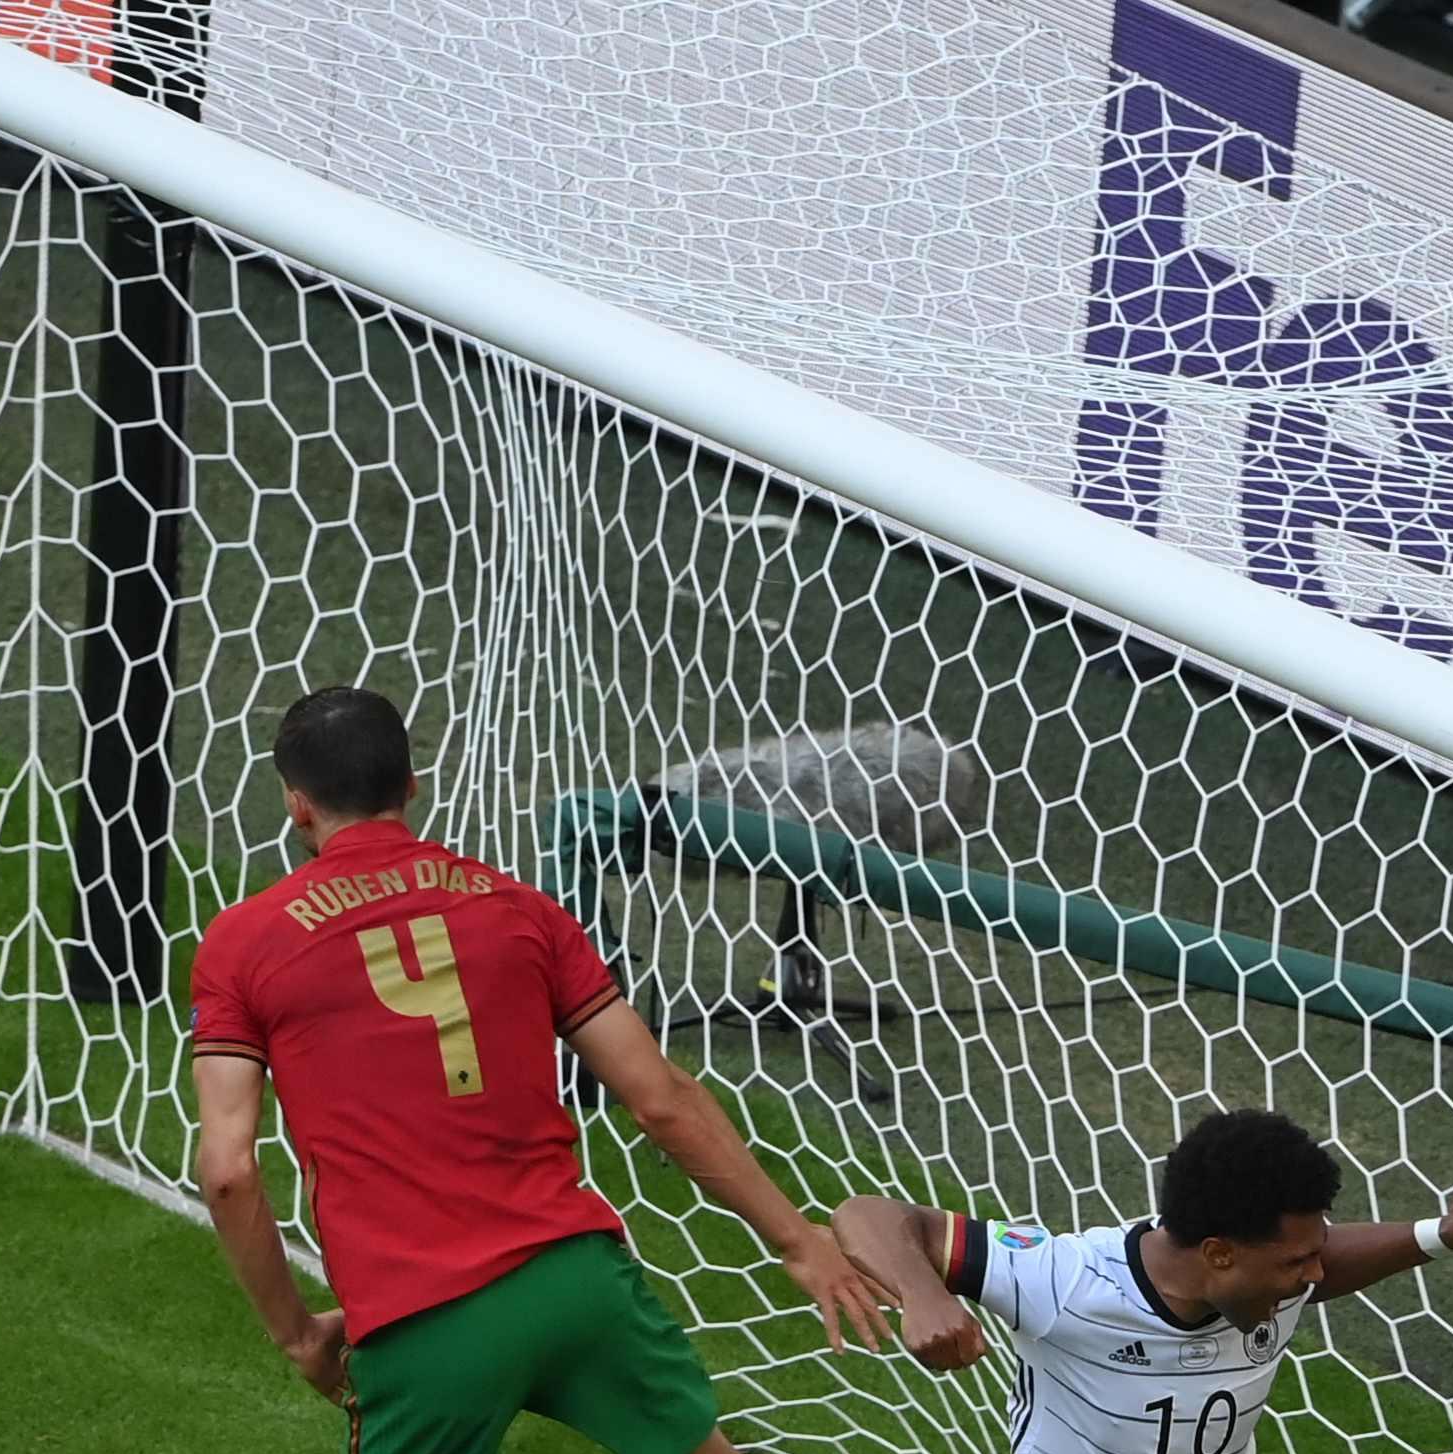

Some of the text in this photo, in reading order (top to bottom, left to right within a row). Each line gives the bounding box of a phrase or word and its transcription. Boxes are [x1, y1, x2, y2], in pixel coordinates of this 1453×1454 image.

[284, 859, 493, 932] RÚBEN DIAS
[356, 914, 484, 1098] 4
[1108, 1352, 1152, 1367] adidas
